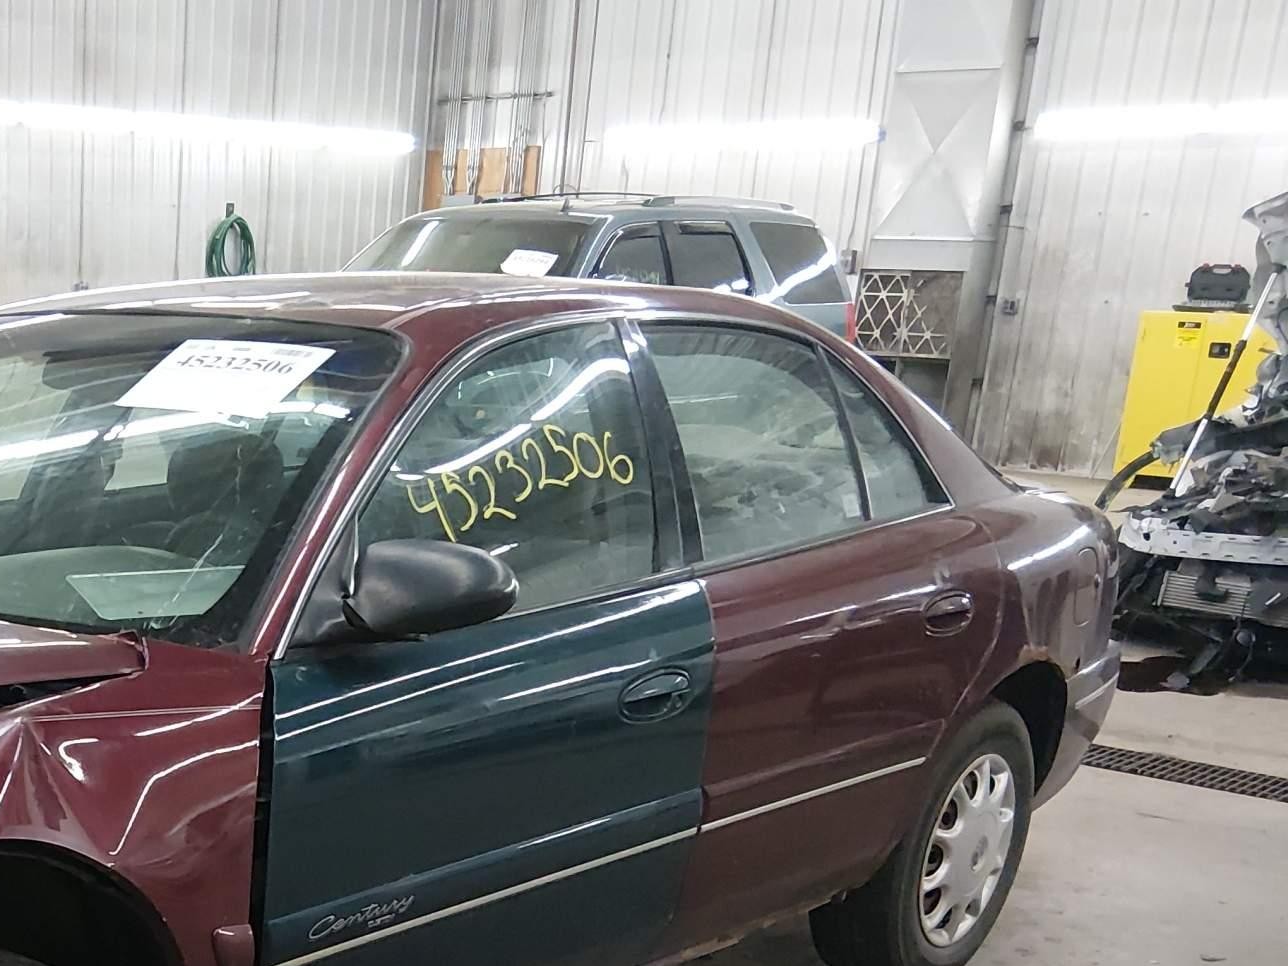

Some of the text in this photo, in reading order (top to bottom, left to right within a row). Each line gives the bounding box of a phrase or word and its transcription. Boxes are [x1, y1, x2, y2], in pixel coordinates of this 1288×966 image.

[176, 354, 295, 375] 45232506
[406, 423, 634, 543] 45232506
[308, 895, 415, 940] Century
